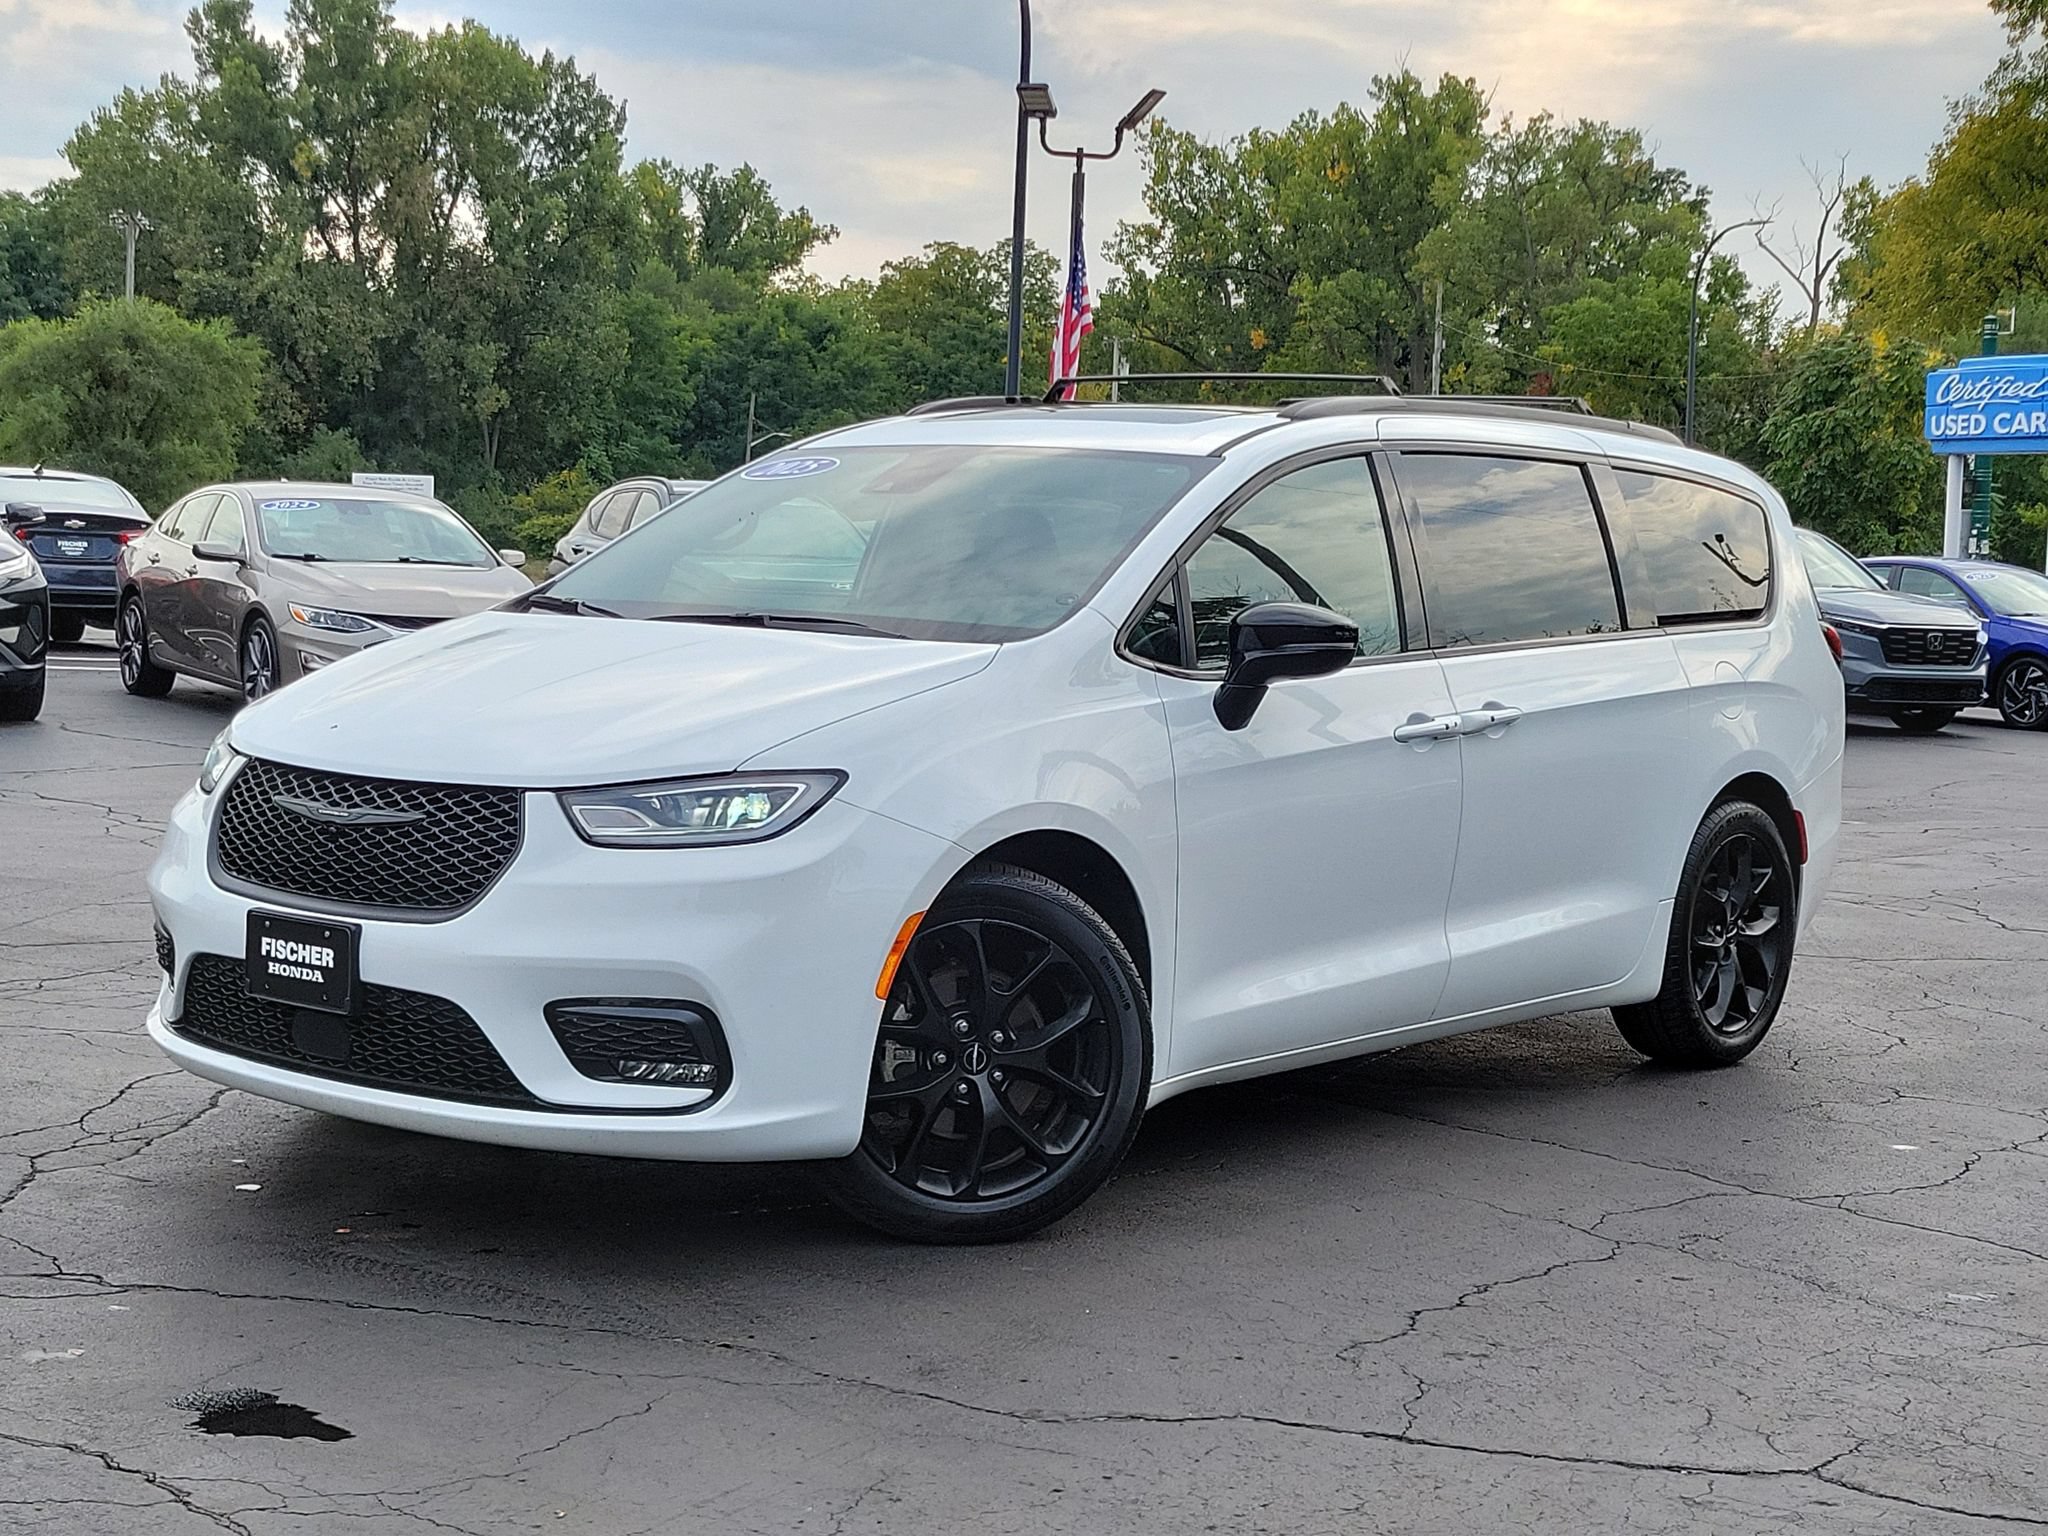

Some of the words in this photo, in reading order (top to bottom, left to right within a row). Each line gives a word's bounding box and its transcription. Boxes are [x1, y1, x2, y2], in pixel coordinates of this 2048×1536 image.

[1936, 374, 2048, 411] Certified
[1930, 413, 1986, 436] USED
[261, 936, 335, 969] FISCHER
[267, 961, 325, 983] HONDA
